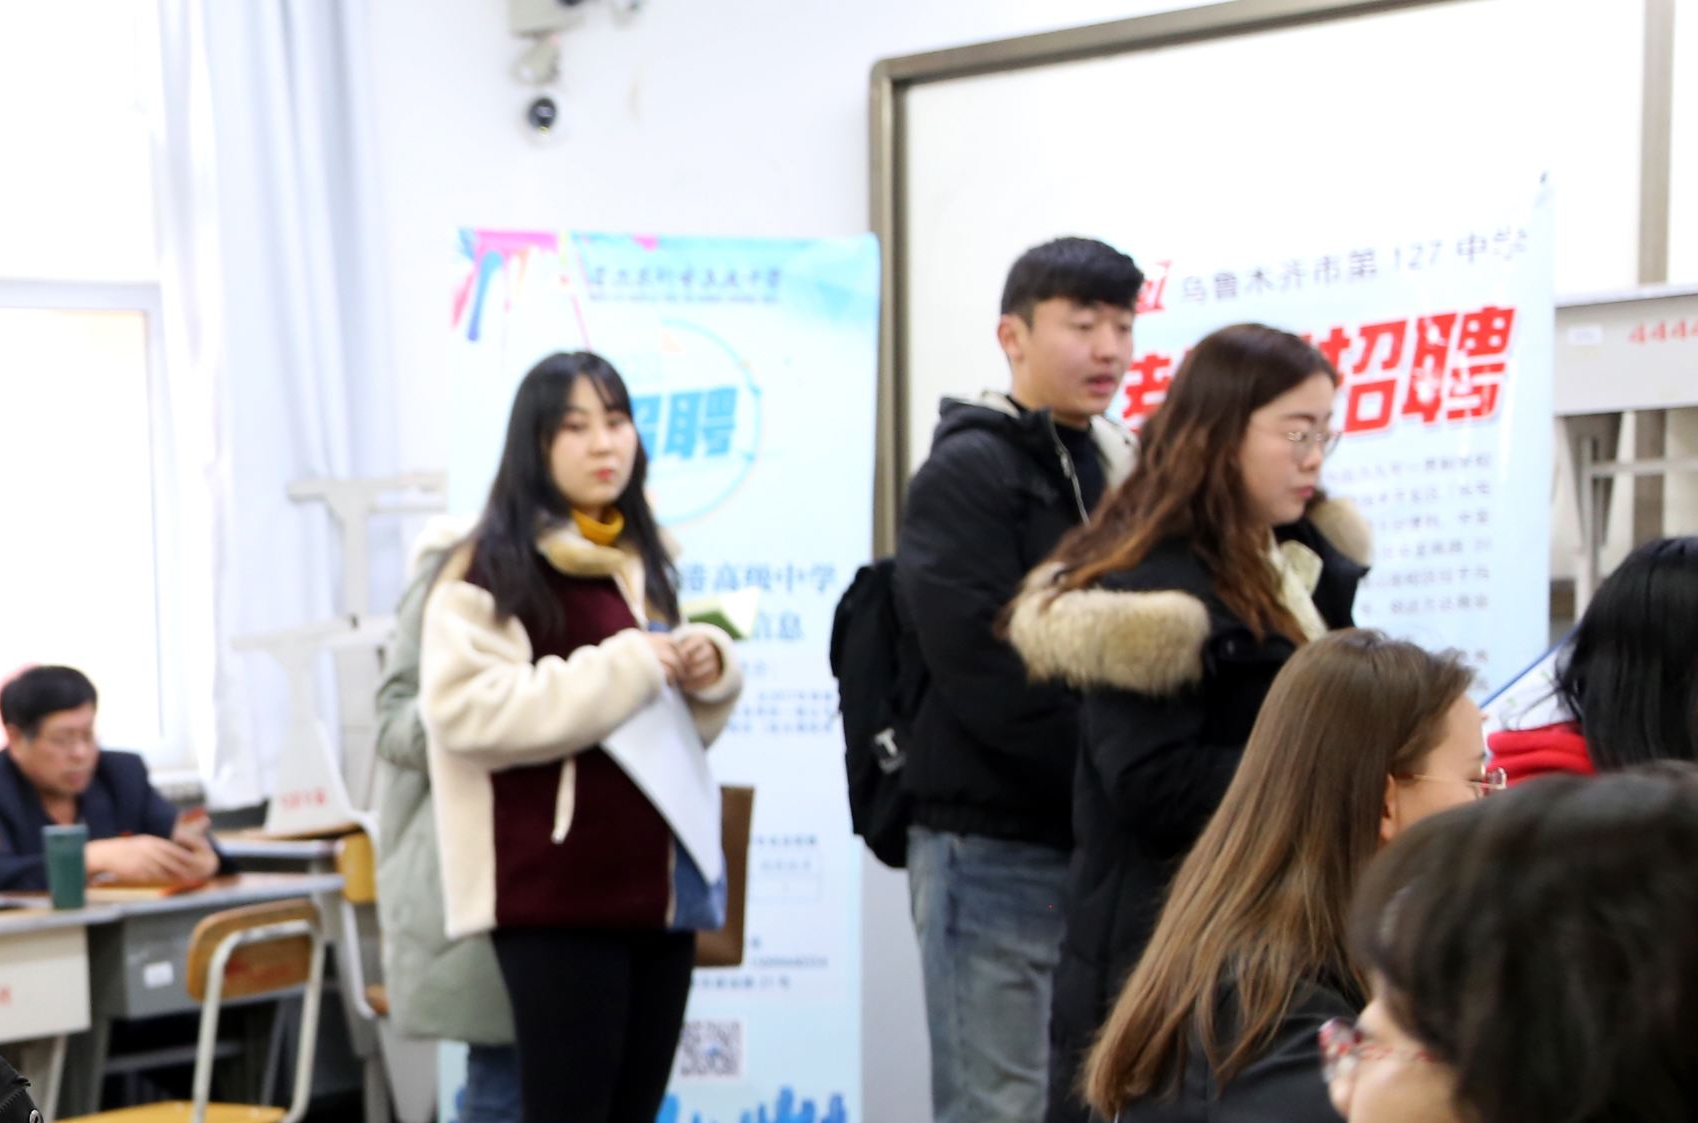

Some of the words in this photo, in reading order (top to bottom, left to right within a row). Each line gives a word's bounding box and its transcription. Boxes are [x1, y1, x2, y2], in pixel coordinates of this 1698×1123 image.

[1181, 246, 1378, 304] 乌鲁木齐市第
[1393, 238, 1445, 272] 127
